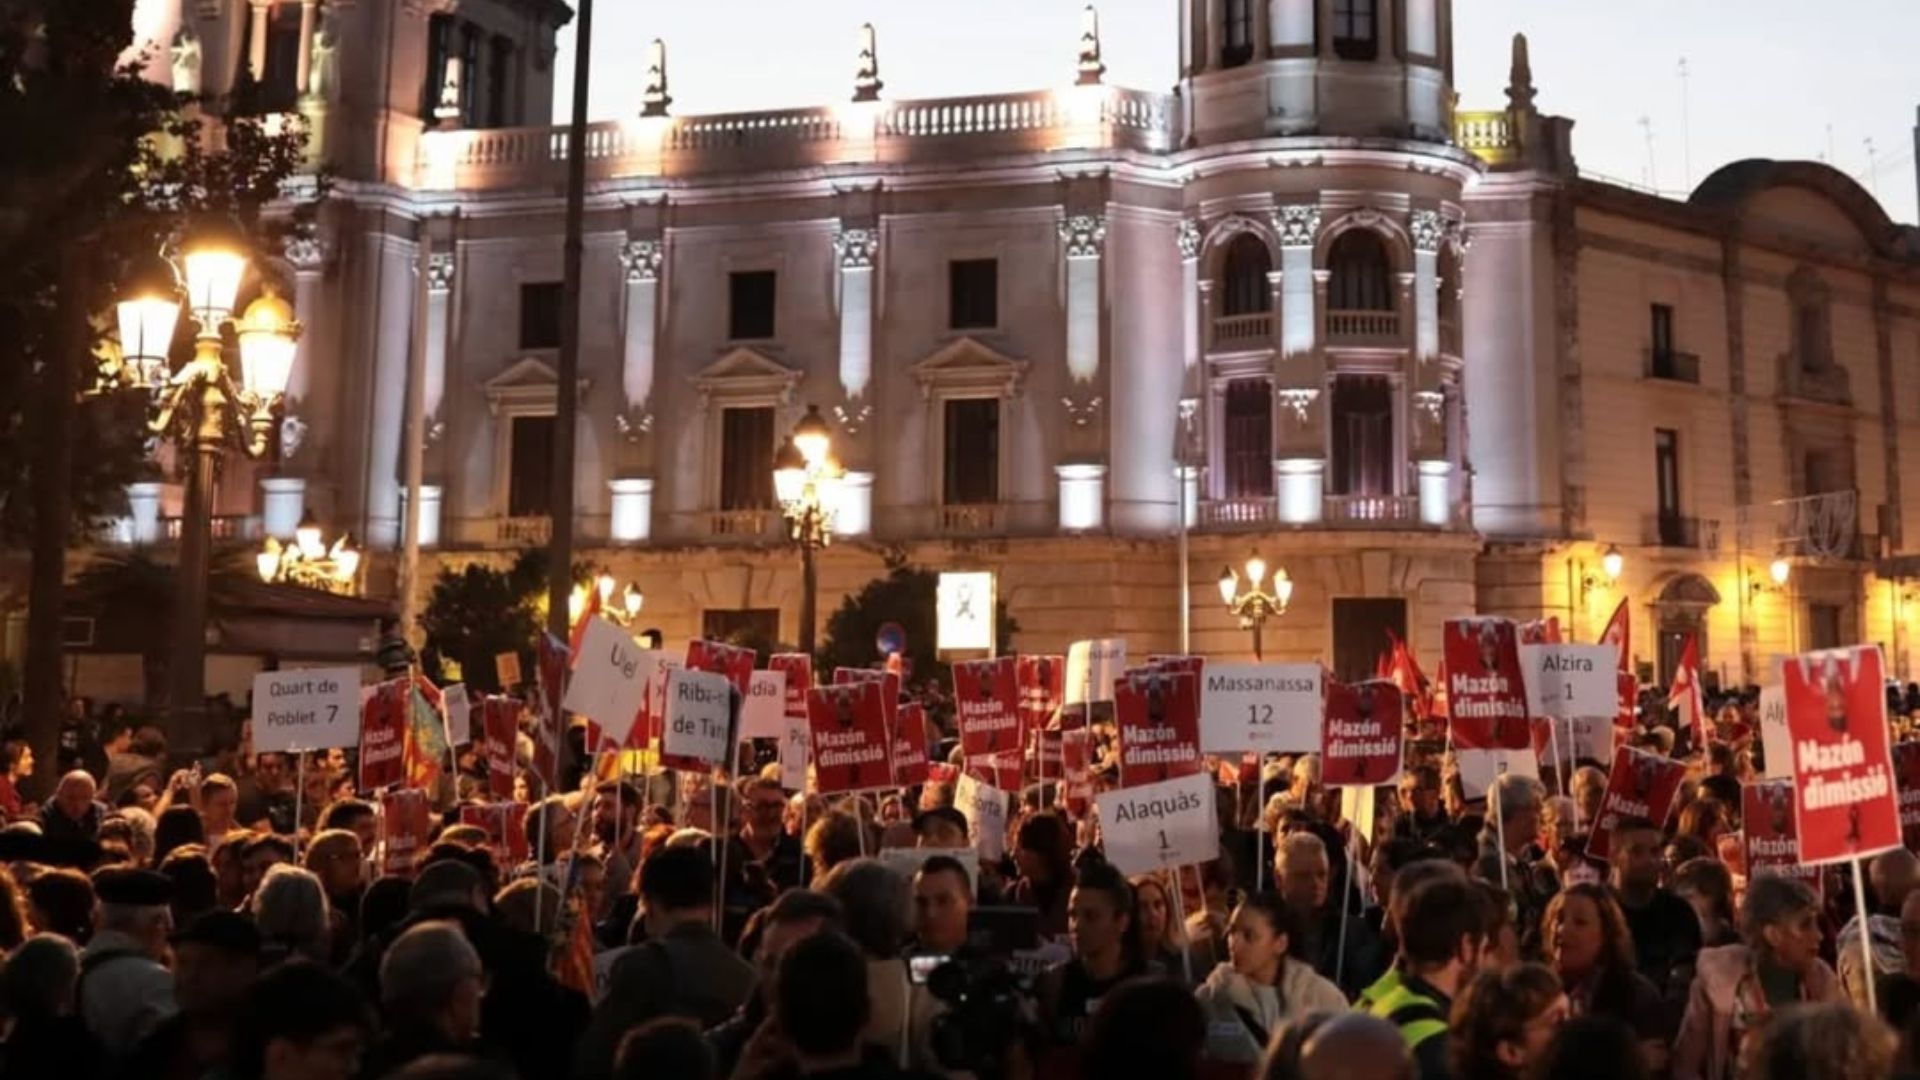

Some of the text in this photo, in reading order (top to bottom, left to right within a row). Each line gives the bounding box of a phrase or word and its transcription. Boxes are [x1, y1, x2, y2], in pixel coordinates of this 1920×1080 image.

[1543, 655, 1593, 672] Alzira
[270, 680, 338, 697] Quart de
[1208, 676, 1313, 692] Massanassa
[1452, 671, 1508, 694] Mazón
[1565, 683, 1573, 700] 1
[268, 705, 338, 726] Poblet 7
[962, 700, 1003, 715] Mazón
[1248, 704, 1273, 724] 12
[1455, 695, 1524, 718] dimissió
[673, 715, 695, 735] de
[1123, 723, 1176, 743] Mazón
[1329, 718, 1381, 737] Mazón
[816, 728, 865, 748] Mazón
[1328, 736, 1396, 757] dimissió
[819, 744, 884, 768] dimissió
[1125, 743, 1195, 764] dimissió
[1798, 733, 1865, 774] Mazón
[1804, 764, 1888, 811] dimissió
[1116, 790, 1201, 823] Alaquàs
[1159, 829, 1169, 849] 1
[1749, 833, 1797, 857] Mazón
